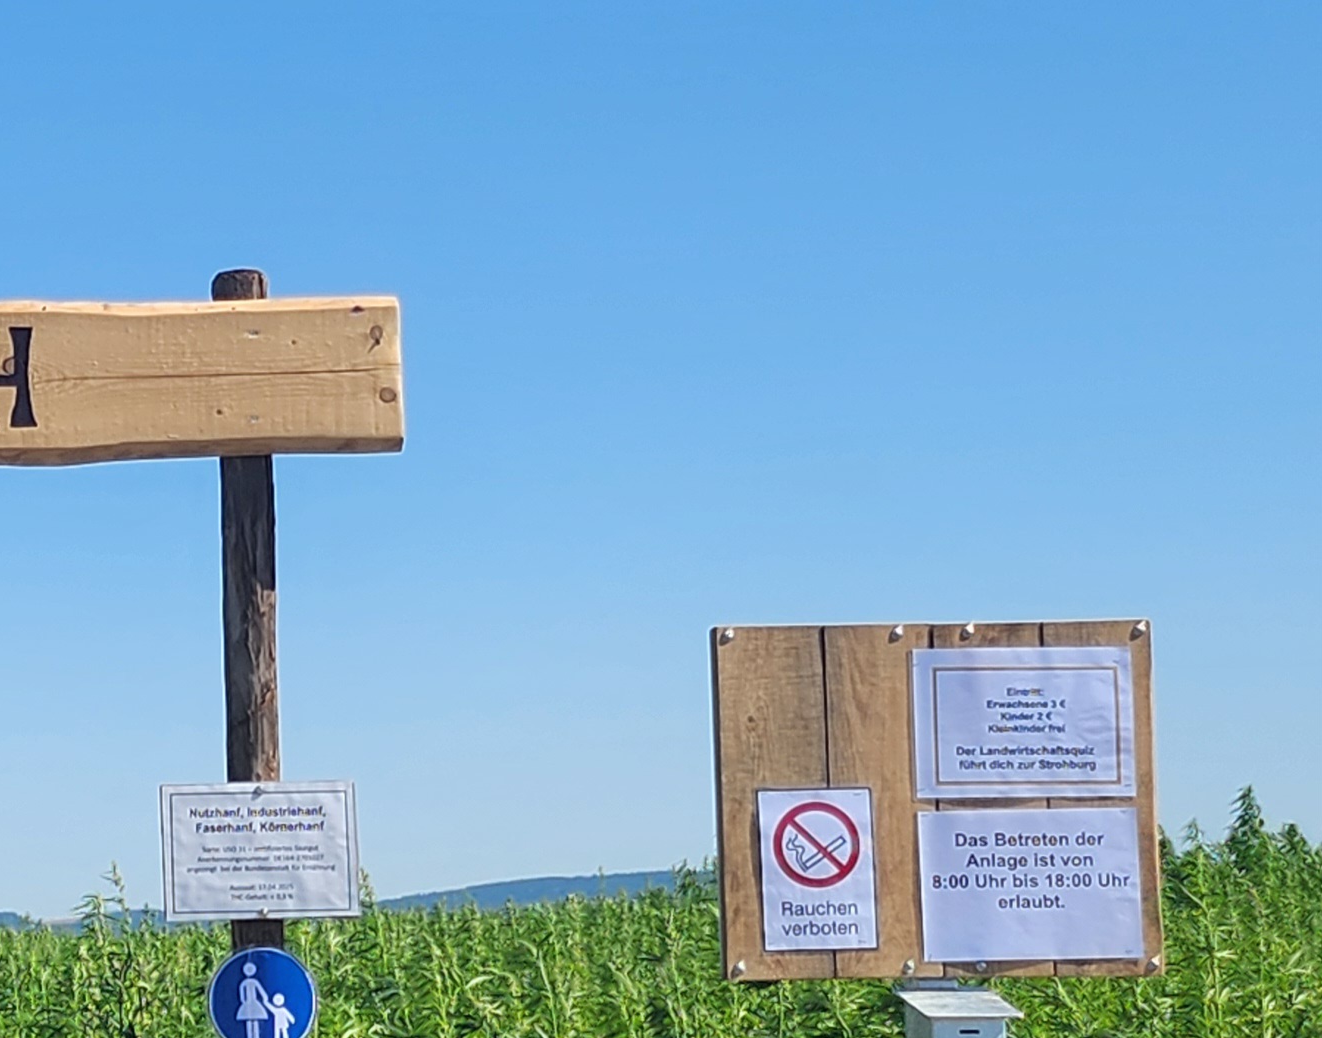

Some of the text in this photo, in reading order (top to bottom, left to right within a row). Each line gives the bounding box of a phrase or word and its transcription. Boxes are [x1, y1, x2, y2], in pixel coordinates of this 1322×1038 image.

[986, 700, 1066, 709] Erwachsene 3 €
[1000, 712, 1052, 721] Kinder 2 €
[988, 724, 1065, 733] Kleinkinder frei
[956, 746, 1095, 757] Der Landwirtschaftsquiz
[959, 760, 1096, 771] führt dich zur Strohburg
[190, 806, 326, 819] Nutzhanf, Industriehanf,
[196, 821, 325, 833] Faserhanf, Körnerhanf
[955, 832, 1104, 847] Das Betreten der
[966, 853, 1094, 871] Anlage ist von
[932, 873, 1129, 889] 8:00 Uhr bis 18:00 Uhr
[998, 894, 1066, 909] erlaubt.
[781, 901, 858, 916] Rauchen
[781, 921, 859, 936] verboten
